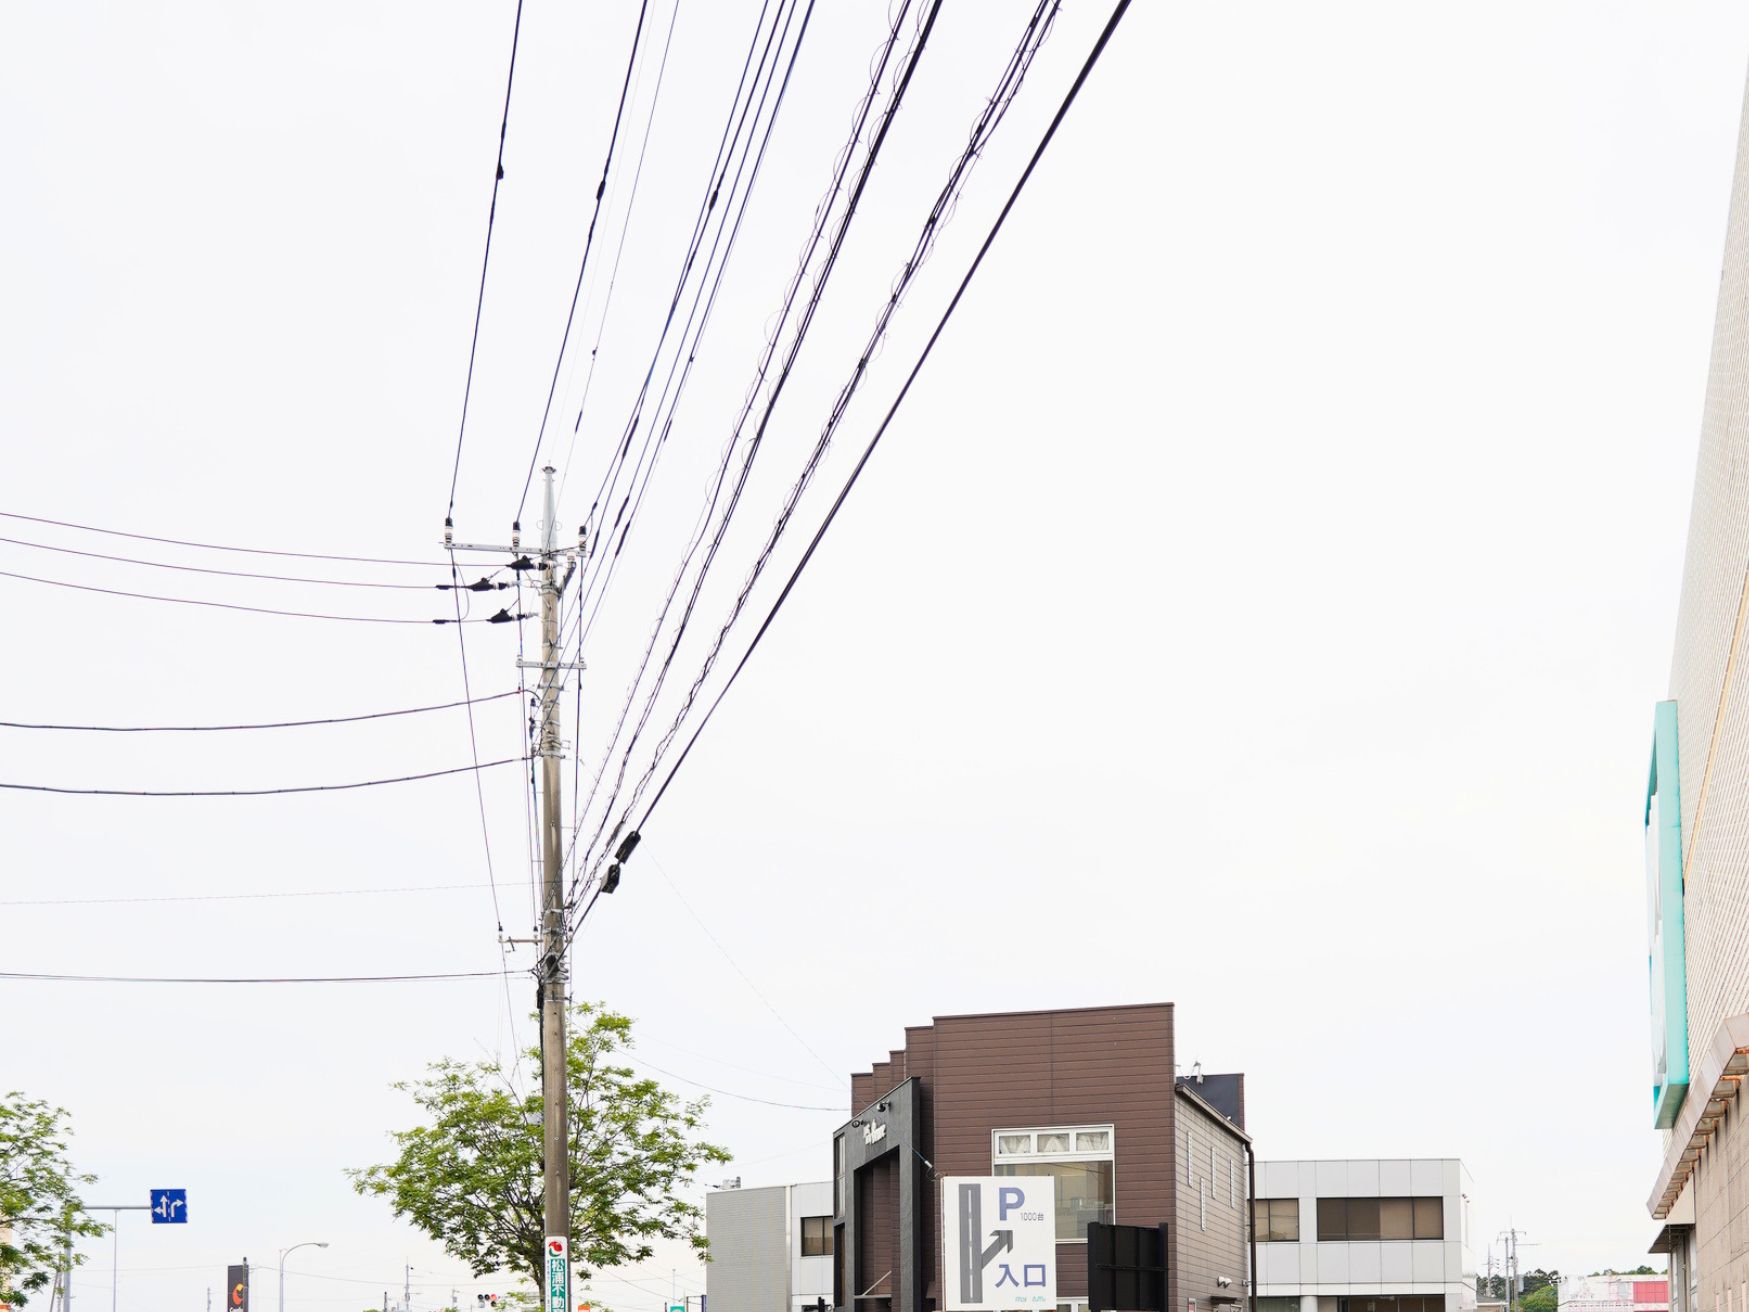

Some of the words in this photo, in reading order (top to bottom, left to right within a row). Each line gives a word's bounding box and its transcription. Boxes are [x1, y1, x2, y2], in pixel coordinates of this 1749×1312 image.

[999, 1187, 1025, 1221] P
[1020, 1212, 1044, 1221] 1000台
[995, 1264, 1046, 1287] 入口
